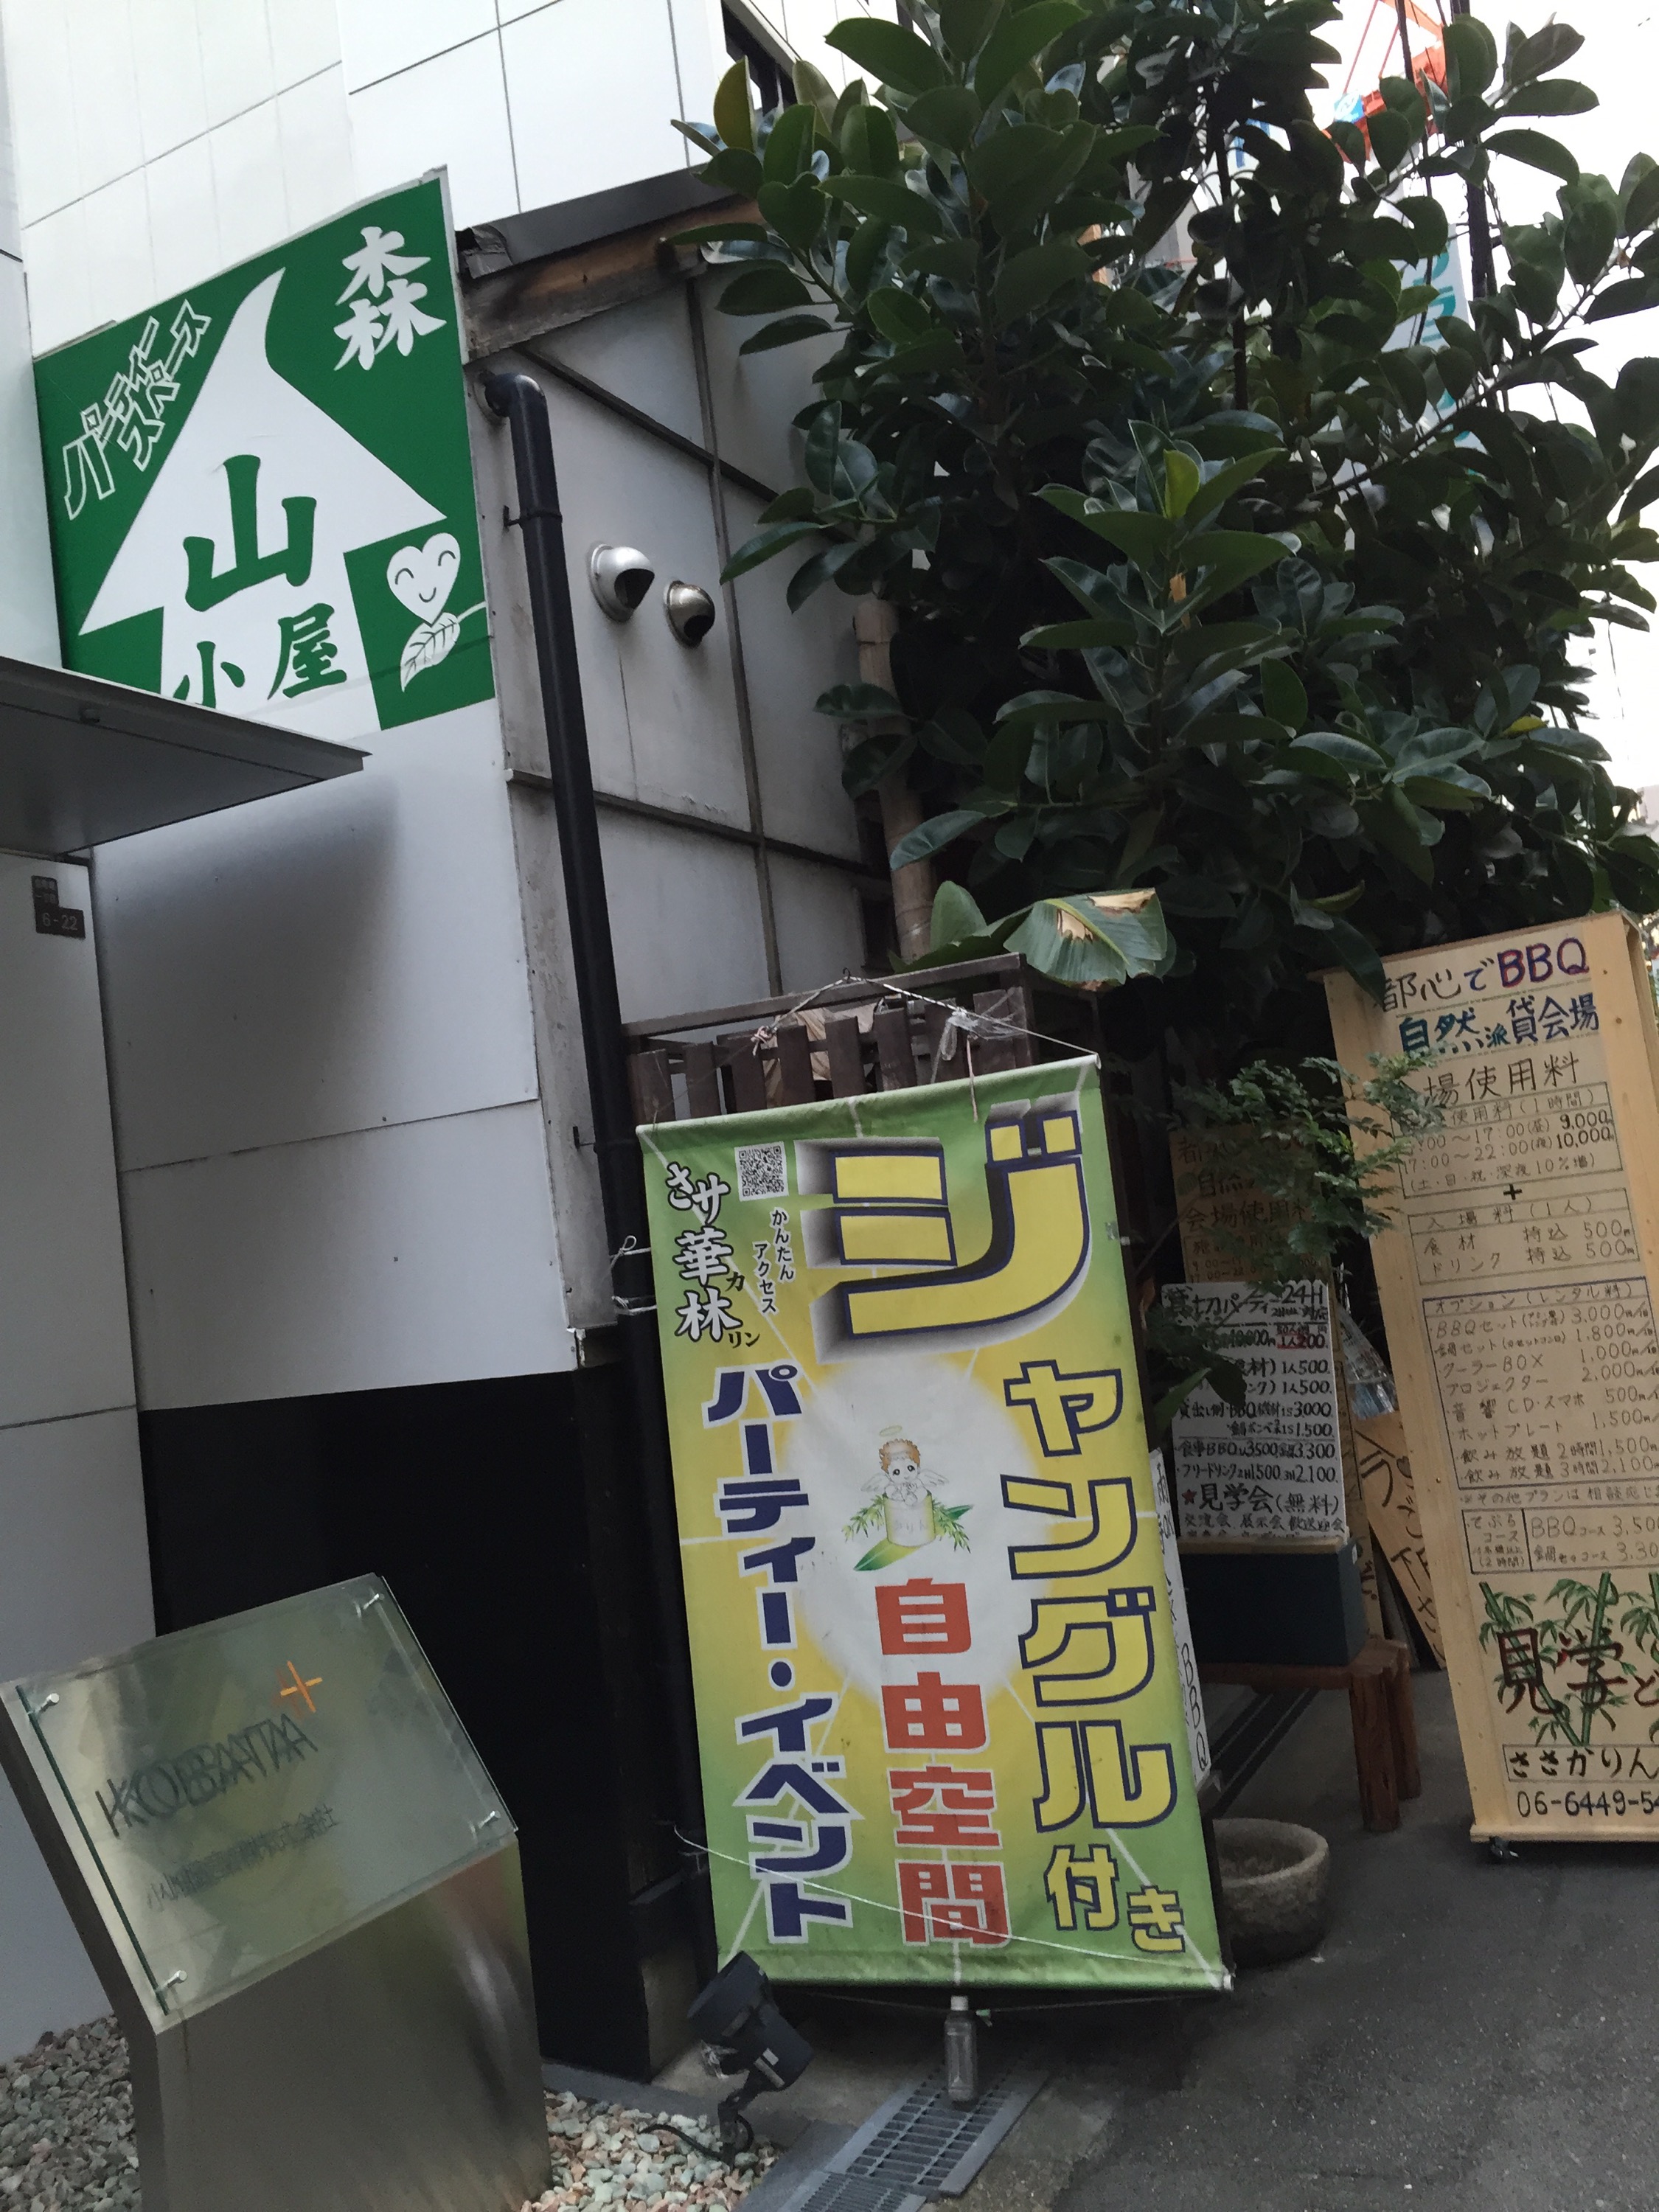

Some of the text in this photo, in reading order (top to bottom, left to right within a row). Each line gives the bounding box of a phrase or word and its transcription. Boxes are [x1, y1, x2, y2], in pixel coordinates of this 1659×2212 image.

[333, 225, 448, 371] 森
[182, 453, 317, 612] 山
[172, 602, 347, 709] 小屋
[1400, 1051, 1579, 1106] 場使用料
[754, 1242, 777, 1314] アクセス
[771, 1208, 795, 1281] かんたん
[1613, 1514, 1659, 1537] 3,50
[1181, 1642, 1208, 1772] BBQ
[874, 1577, 1011, 1950] 自由空間
